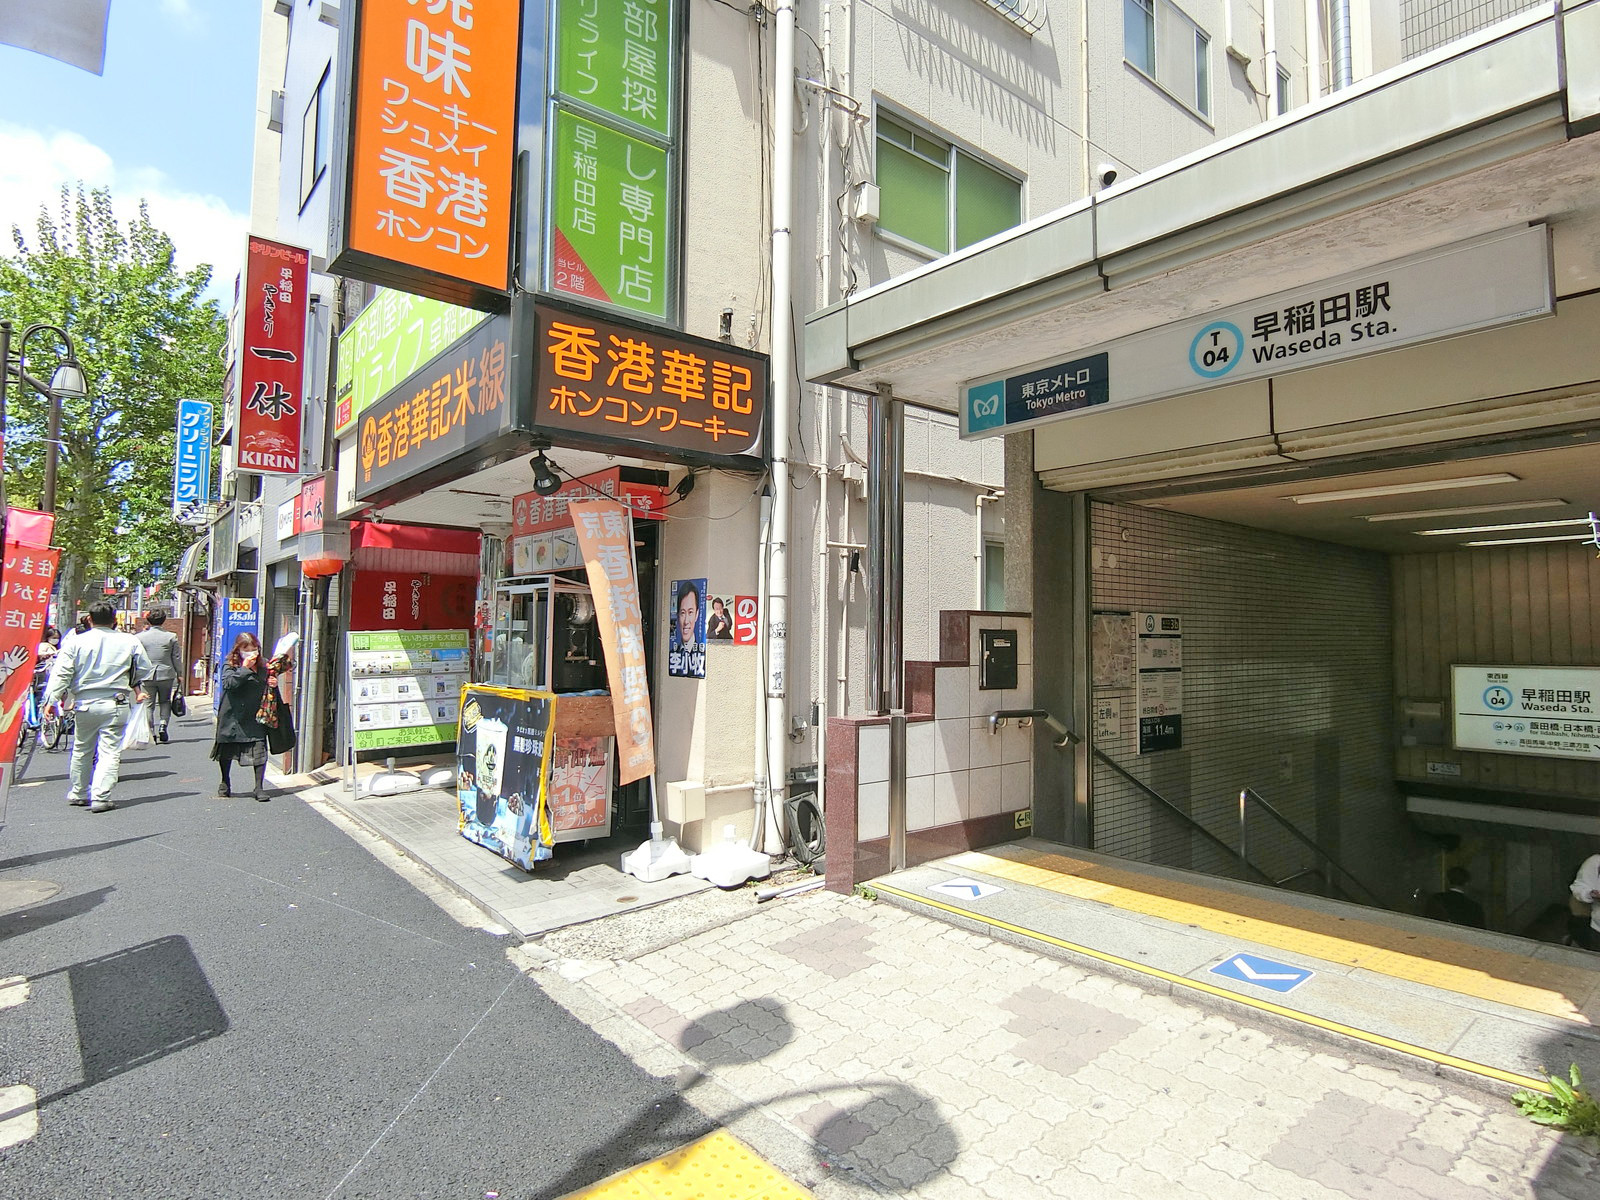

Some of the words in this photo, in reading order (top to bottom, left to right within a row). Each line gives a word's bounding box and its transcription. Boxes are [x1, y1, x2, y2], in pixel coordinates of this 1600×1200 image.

[383, 78, 498, 136] ワーキー
[380, 107, 488, 168] シュメイ
[379, 147, 489, 228] 香港
[572, 124, 598, 236] 早稲田店
[250, 241, 308, 265] キリンビール
[376, 209, 490, 259] ホンコン
[556, 271, 585, 292] 2階
[558, 257, 585, 273] 当ビル
[279, 267, 293, 304] 早稲田
[262, 283, 279, 339] やきとり
[1251, 281, 1391, 343] 早稲田駅
[1203, 347, 1230, 367] 04
[1210, 331, 1221, 347] T
[1252, 330, 1342, 364] Waseda
[1350, 320, 1398, 343] Sta.
[246, 346, 298, 421] 一休
[547, 320, 753, 415] 香港華記
[1021, 368, 1090, 400] 東京メトロ
[377, 338, 506, 468] 香港華記米線
[549, 385, 750, 442] ホンコンワーキー
[1025, 397, 1054, 411] Tokyo
[1055, 388, 1086, 404] Metro
[178, 412, 201, 499] クリーニング
[241, 449, 297, 471] KIRIN
[229, 611, 257, 621] Asahi
[231, 602, 250, 612] 100
[737, 598, 758, 642] のづ
[1490, 697, 1506, 706] 04
[1521, 688, 1591, 704] 早稲田駅
[1521, 702, 1567, 713] Waseda
[1571, 704, 1594, 714] Sta.
